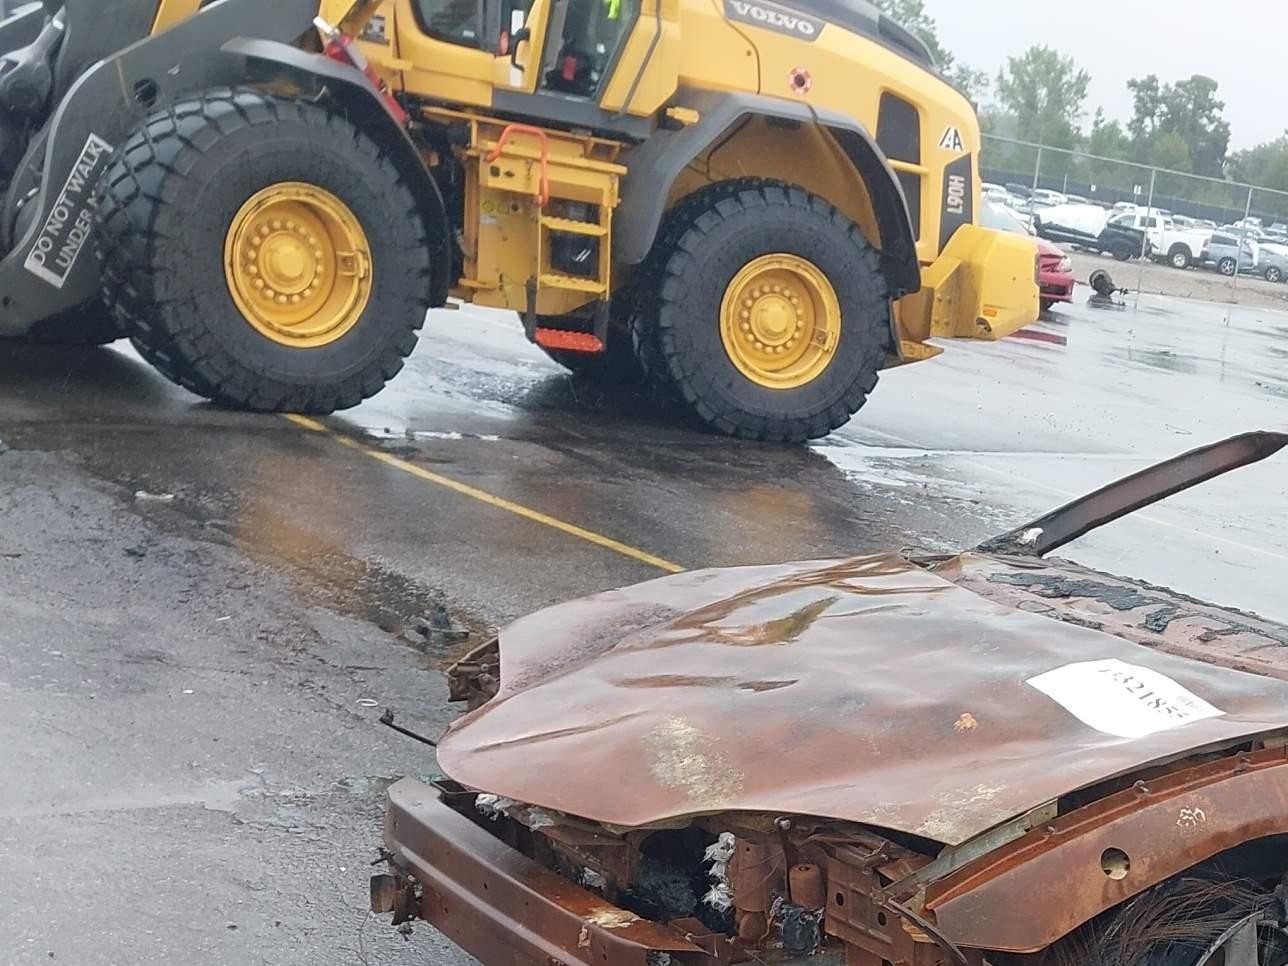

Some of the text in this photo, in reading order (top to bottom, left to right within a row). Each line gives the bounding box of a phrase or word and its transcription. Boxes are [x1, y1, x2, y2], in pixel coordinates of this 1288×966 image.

[729, 0, 815, 35] VOLVO
[32, 235, 53, 266] DO
[46, 193, 75, 236] NOT
[68, 142, 103, 193] WALK
[946, 174, 965, 214] L90H
[55, 208, 93, 268] UNDER
